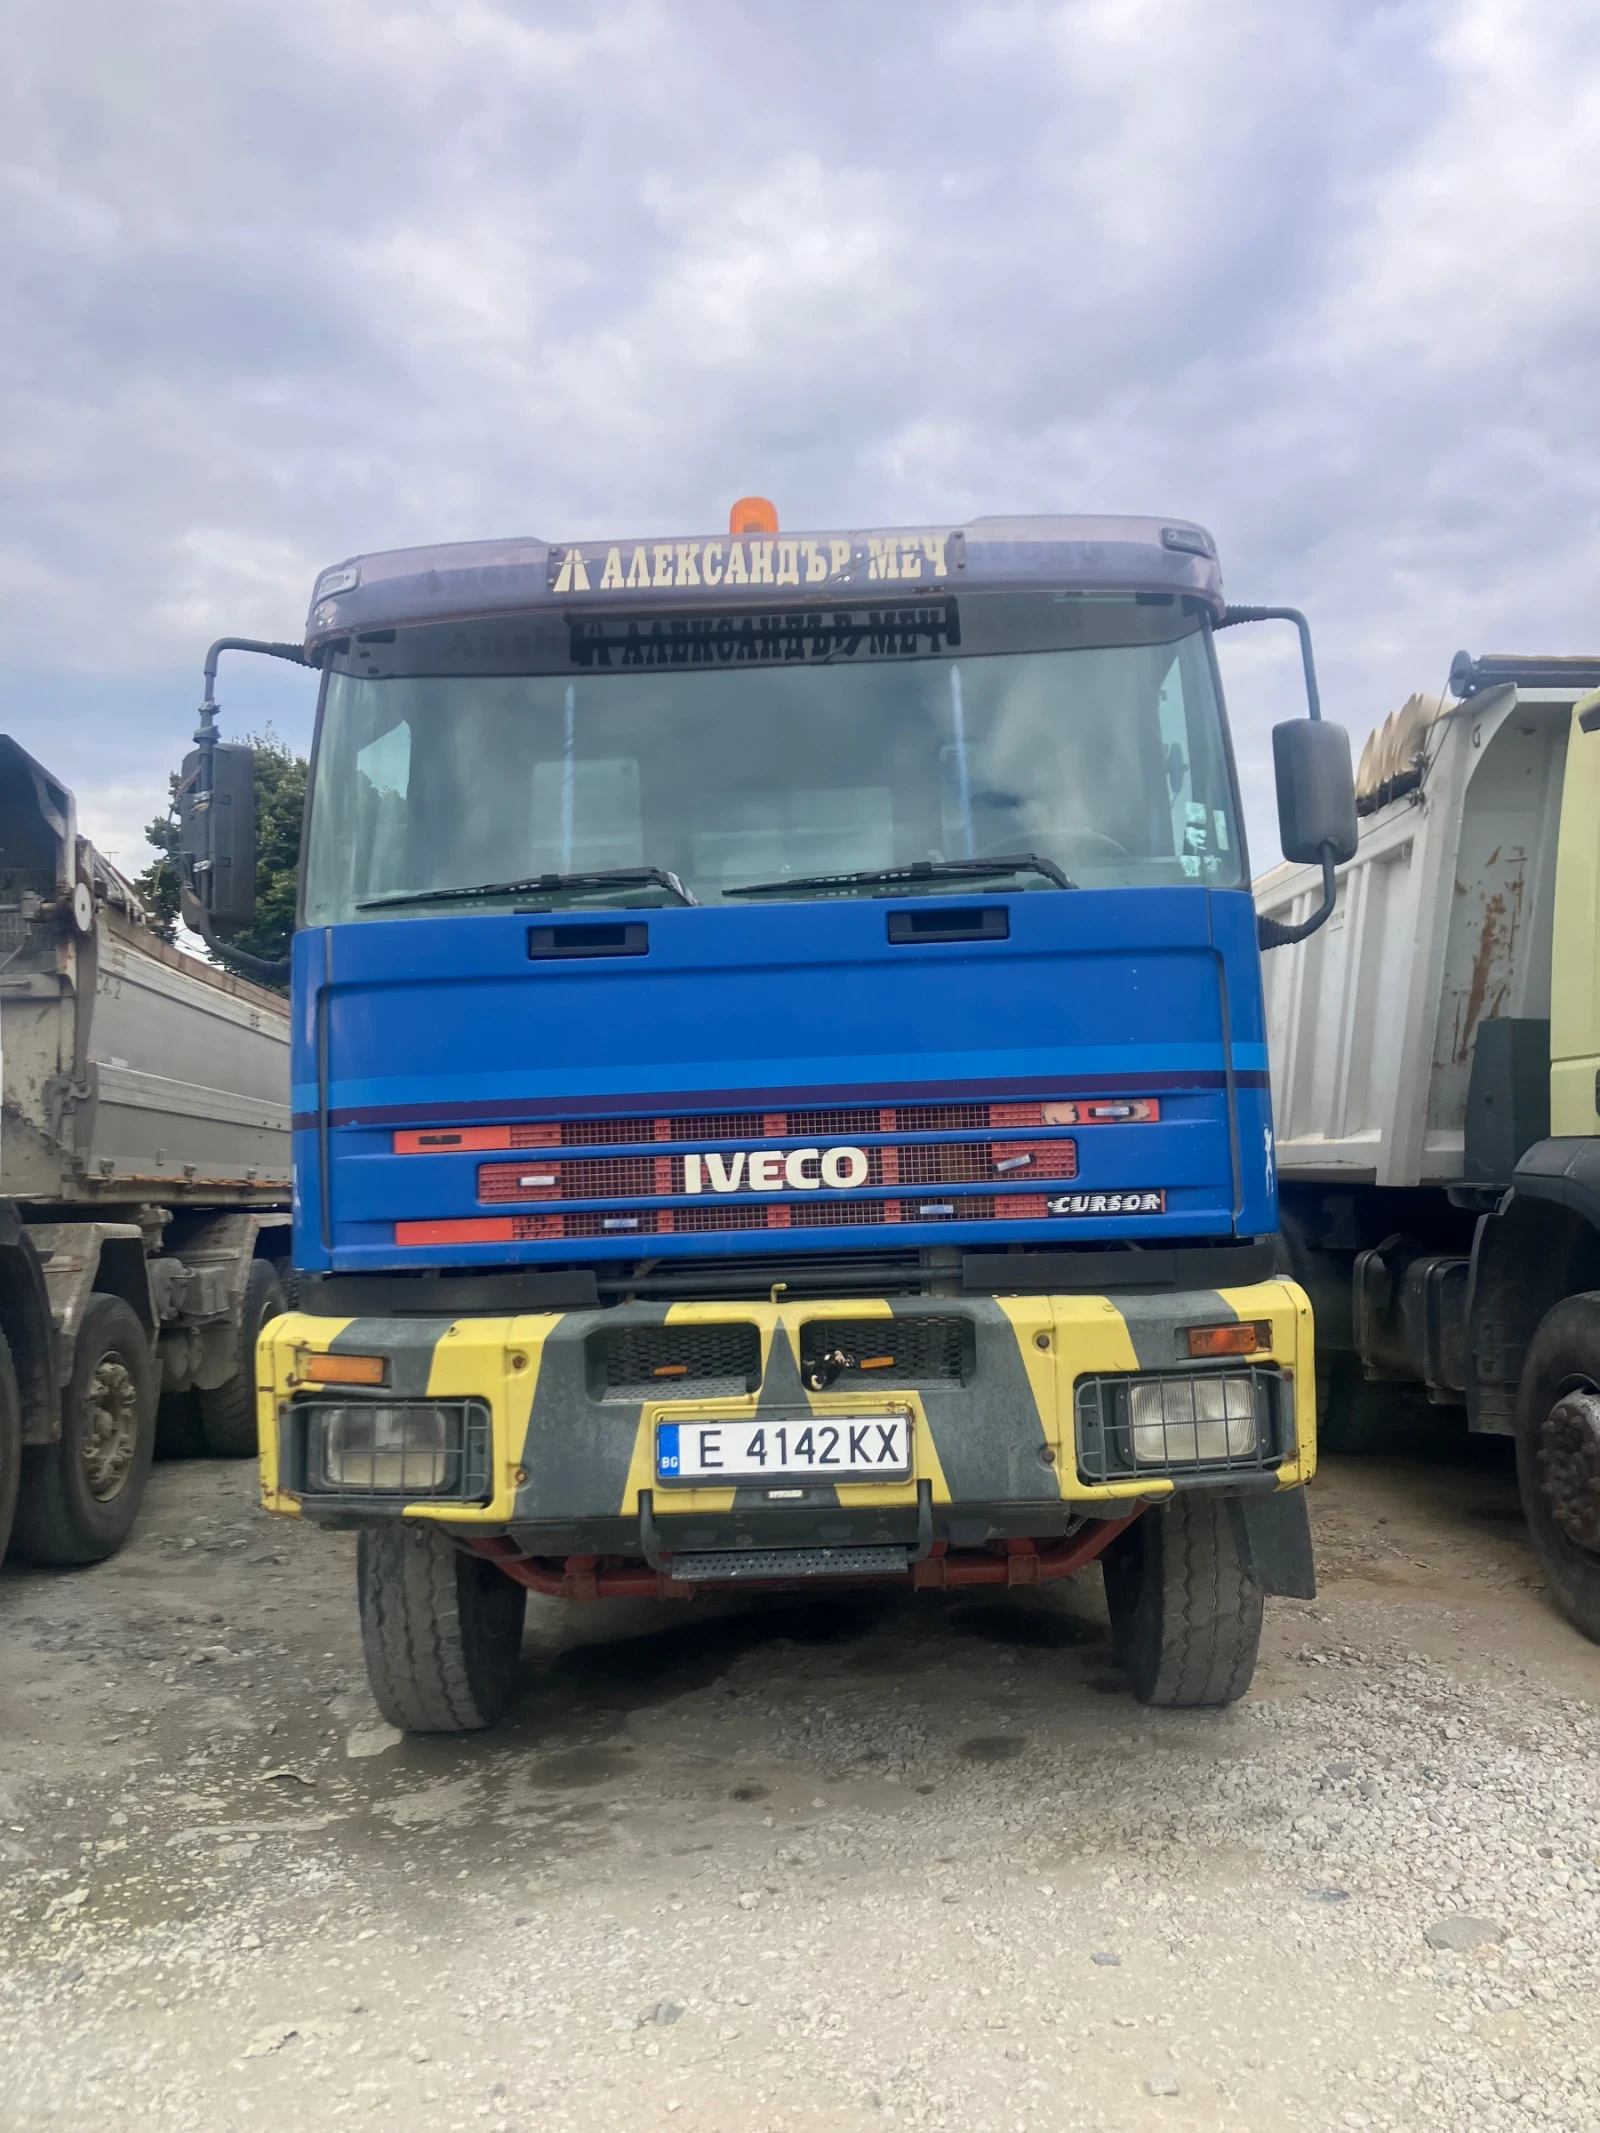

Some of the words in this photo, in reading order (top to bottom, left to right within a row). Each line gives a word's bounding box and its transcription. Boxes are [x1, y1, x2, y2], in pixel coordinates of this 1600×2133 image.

[600, 539, 851, 590] АЛЕКСАНДЪР
[867, 536, 949, 580] МЕЧ
[683, 1146, 869, 1195] IVECO
[1051, 1194, 1158, 1213] CURSOR
[661, 1456, 679, 1469] BG
[700, 1430, 724, 1468] E
